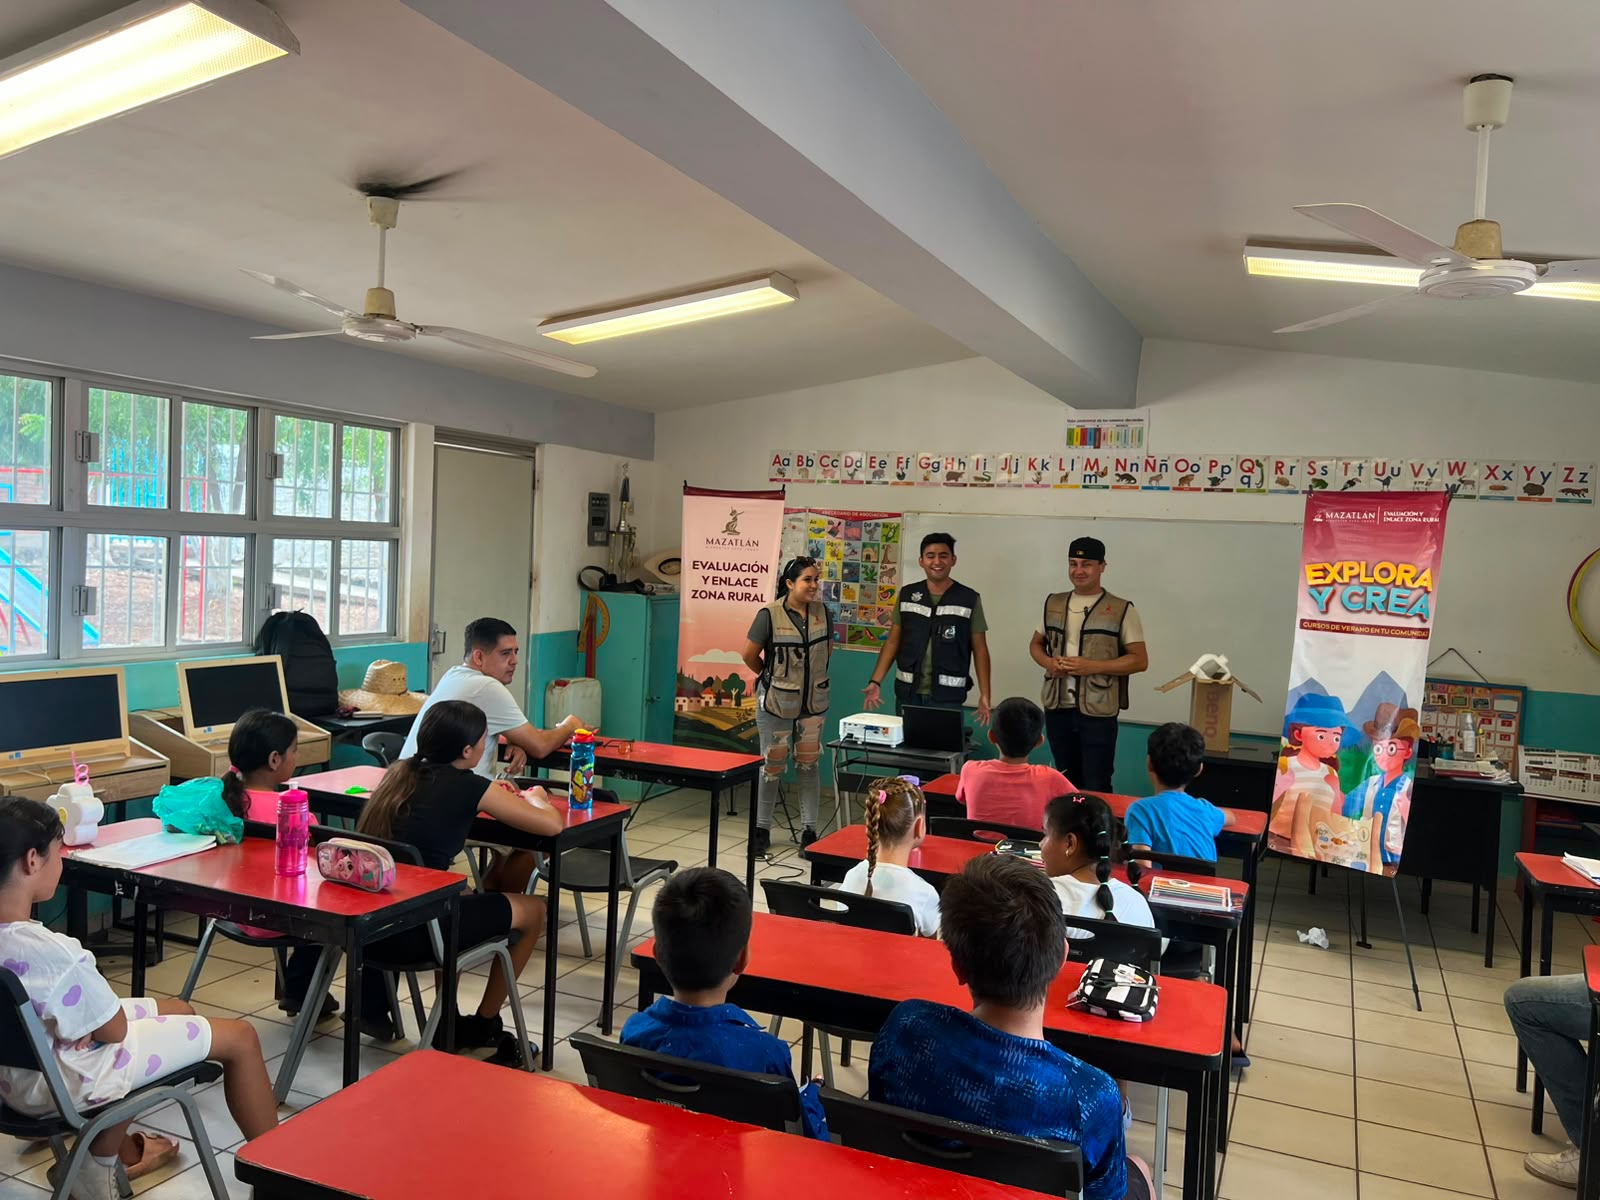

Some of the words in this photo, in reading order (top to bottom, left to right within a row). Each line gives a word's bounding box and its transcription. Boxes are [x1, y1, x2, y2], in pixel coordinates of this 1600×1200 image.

[772, 454, 790, 466] Aa
[797, 455, 814, 467] Bb
[819, 455, 839, 468] Cc
[844, 456, 862, 468] Dd
[869, 456, 887, 468] Ee
[896, 457, 910, 469] Ff
[919, 456, 940, 472] Gg
[1175, 458, 1200, 473] Oo
[1325, 510, 1376, 520] MAZATLÁN
[692, 560, 768, 573] EVALUACIÓN
[702, 576, 710, 584] Y
[712, 576, 758, 587] ENLACE
[1305, 561, 1433, 592] EXPLORA
[691, 590, 726, 600] ZONA
[728, 591, 766, 603] RURAL
[1308, 587, 1335, 614] Y
[1341, 586, 1430, 622] CREA
[1303, 621, 1330, 630] CURSOS
[1341, 625, 1370, 633] VERANO
